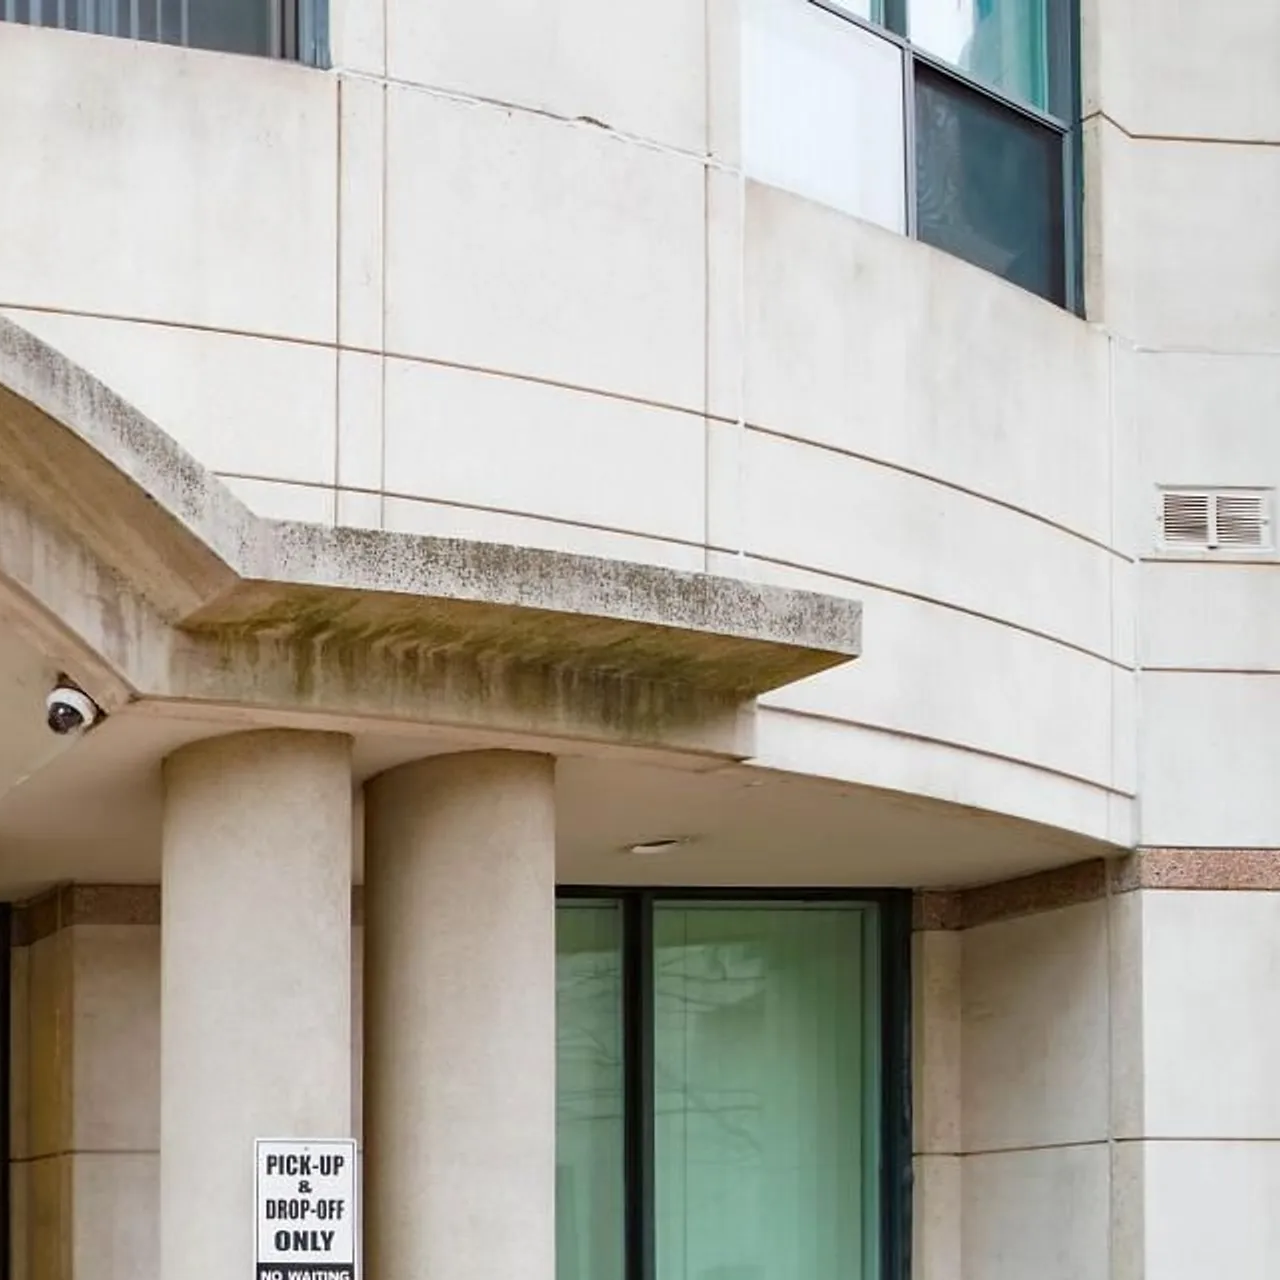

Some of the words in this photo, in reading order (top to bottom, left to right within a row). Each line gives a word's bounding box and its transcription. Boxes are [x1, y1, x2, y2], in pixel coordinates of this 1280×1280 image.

[266, 1154, 344, 1176] PICK-UP
[298, 1180, 312, 1194] &
[266, 1199, 344, 1220] DROP-OFF
[274, 1230, 335, 1252] ONLY
